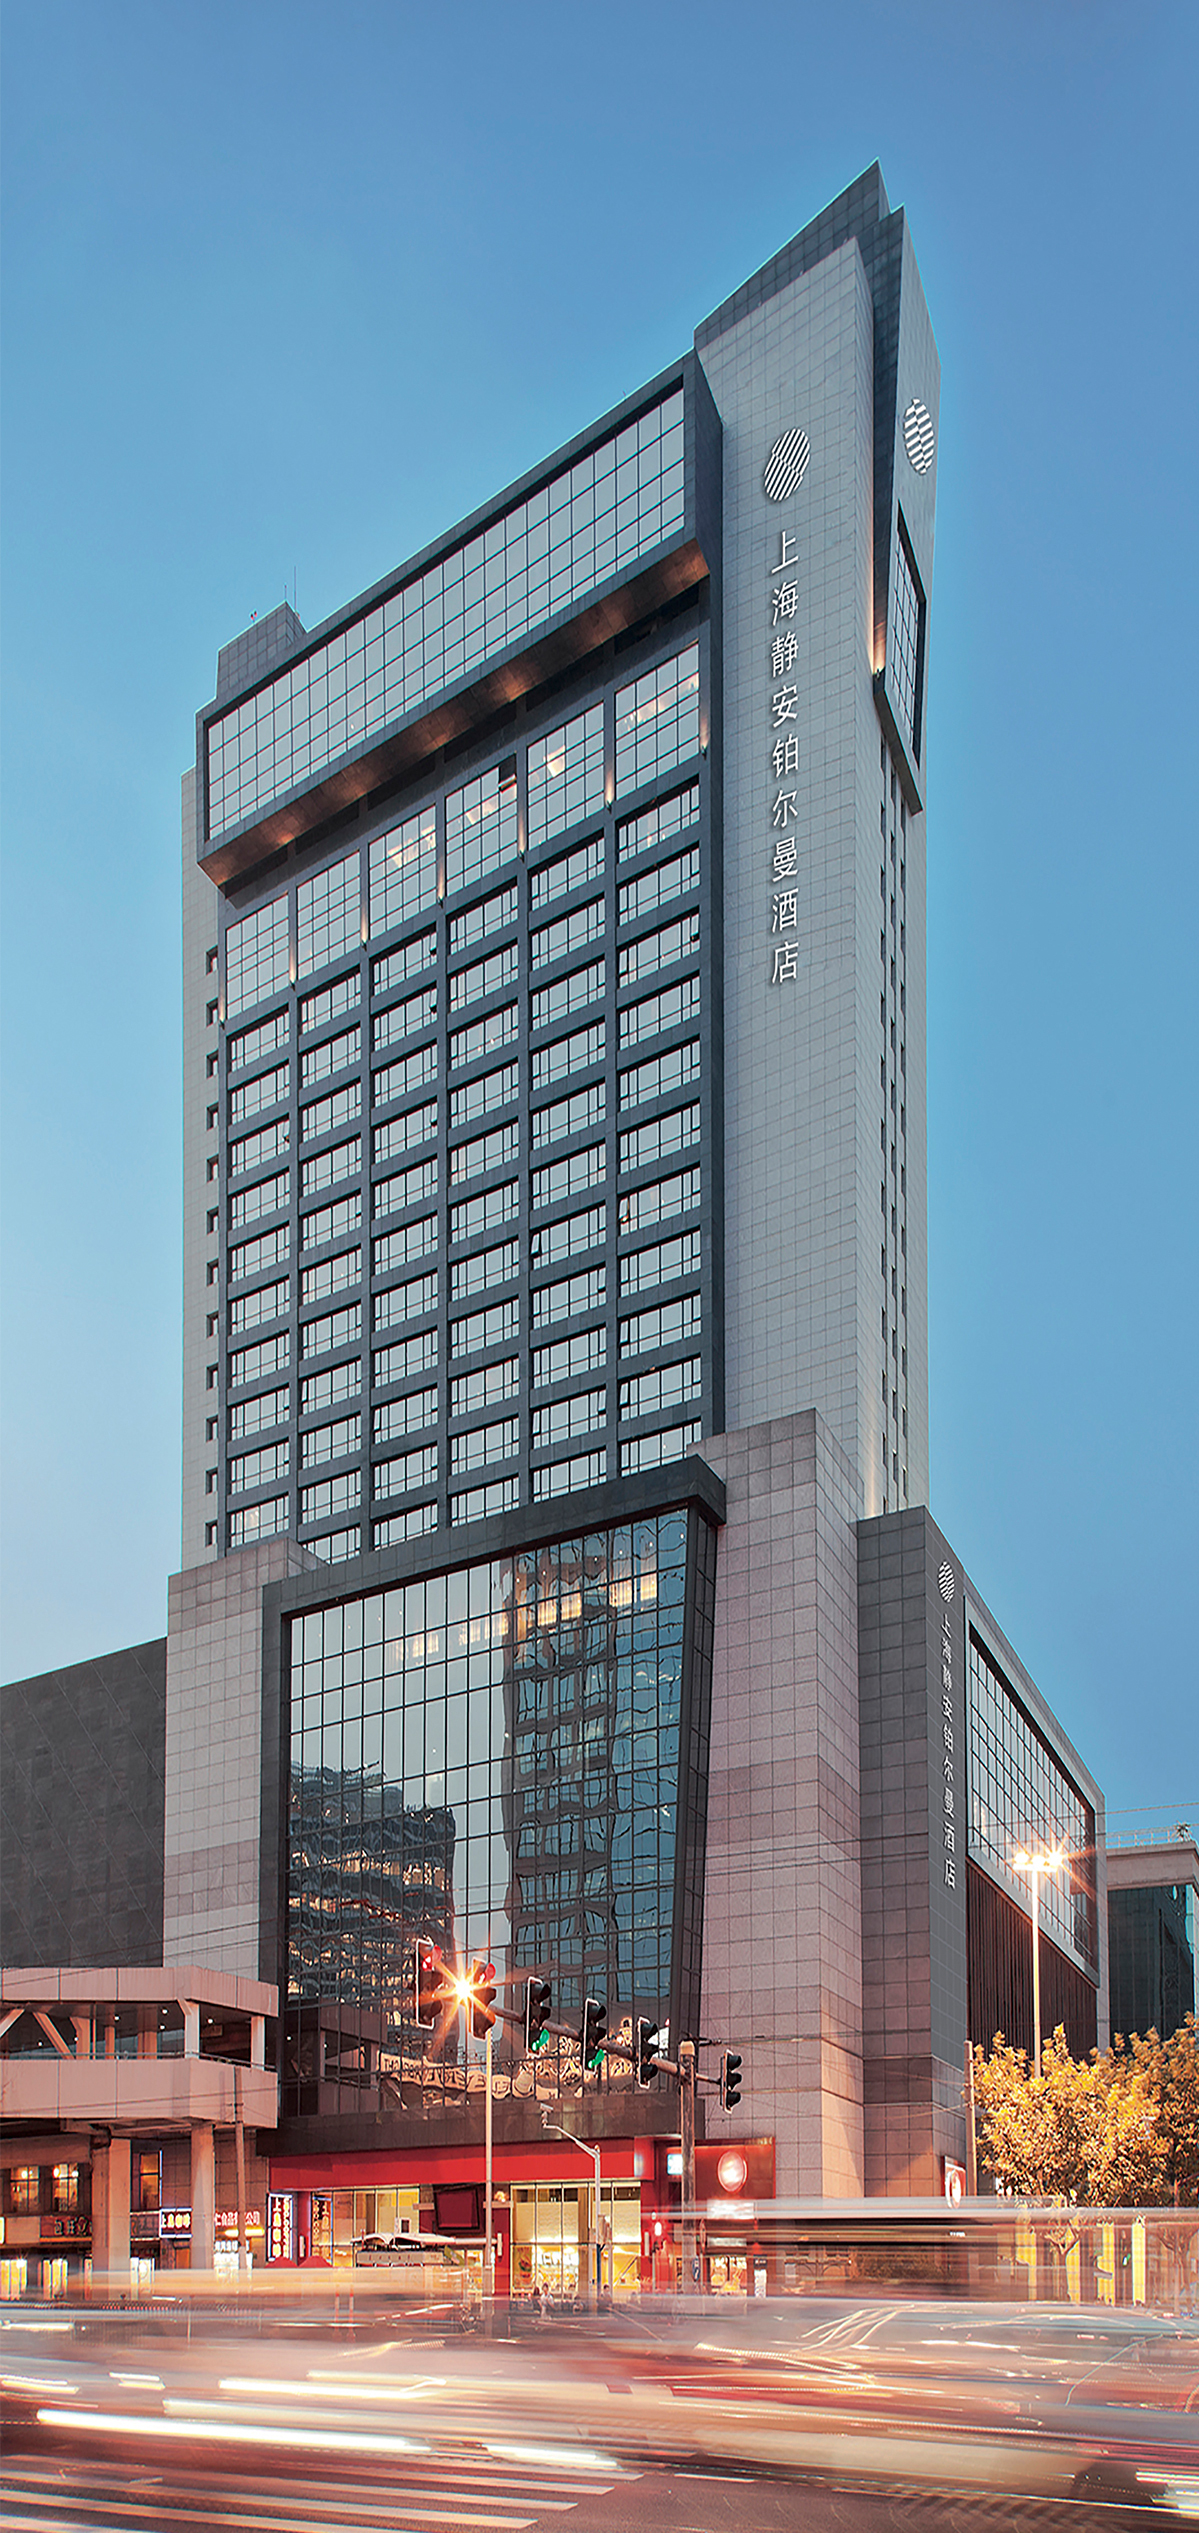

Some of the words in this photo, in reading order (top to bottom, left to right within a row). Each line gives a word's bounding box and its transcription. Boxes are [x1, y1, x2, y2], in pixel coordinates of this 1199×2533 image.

[771, 531, 799, 984] 上海静安铂尔曼酒店
[941, 1613, 956, 1890] 上海静安铂尔曼酒店
